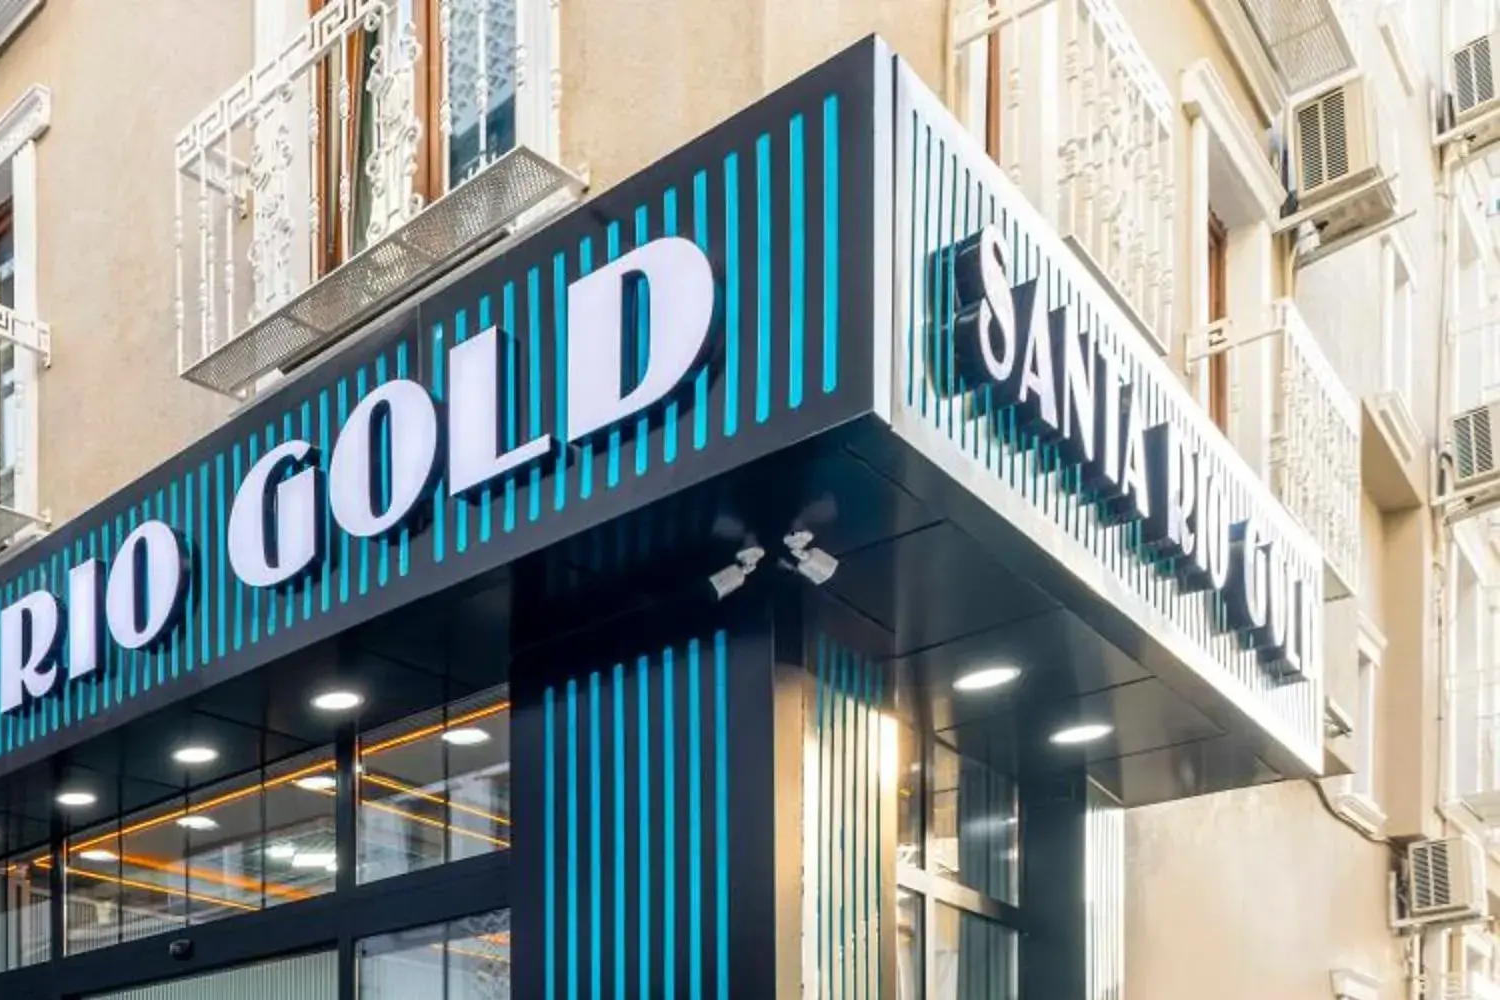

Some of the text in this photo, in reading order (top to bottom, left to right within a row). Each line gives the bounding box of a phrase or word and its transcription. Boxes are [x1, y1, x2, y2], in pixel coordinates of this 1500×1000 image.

[0, 519, 181, 715] RIO
[228, 236, 714, 587] GOLD
[979, 223, 1150, 518] SANTA
[1168, 424, 1229, 588] RIO
